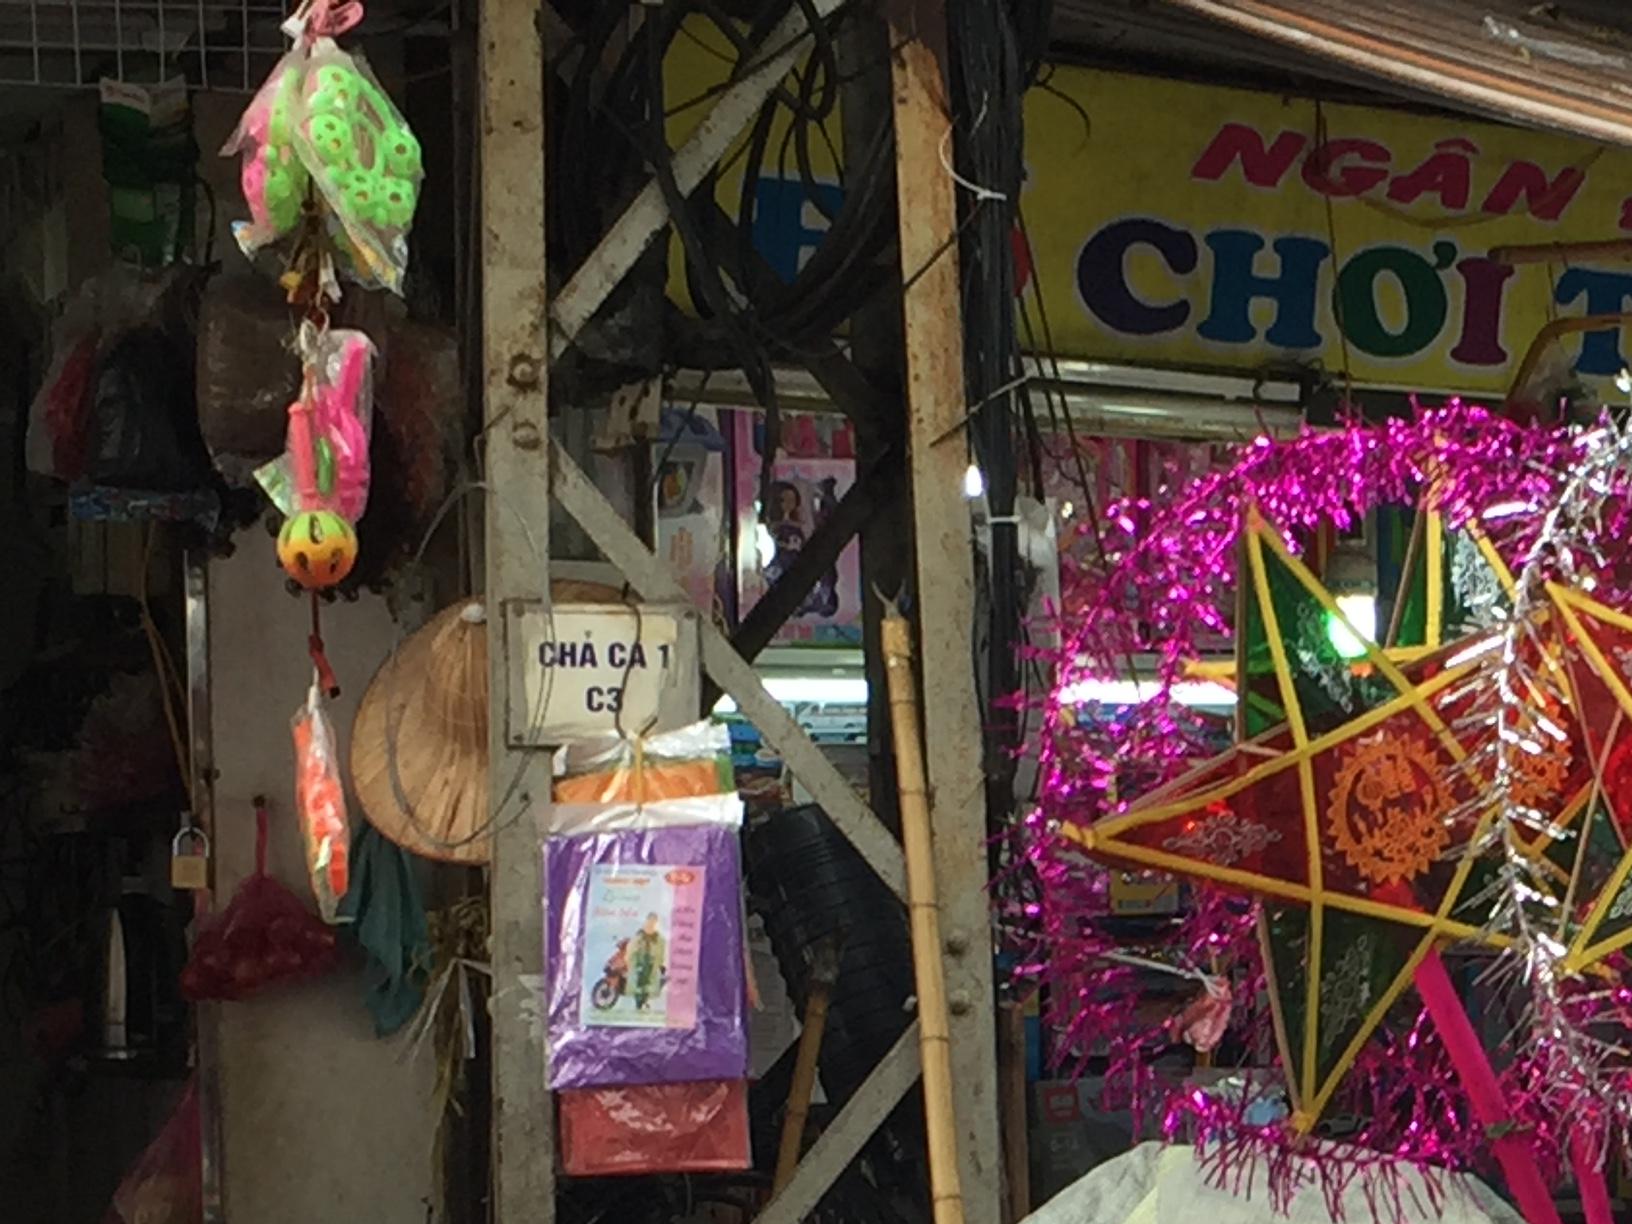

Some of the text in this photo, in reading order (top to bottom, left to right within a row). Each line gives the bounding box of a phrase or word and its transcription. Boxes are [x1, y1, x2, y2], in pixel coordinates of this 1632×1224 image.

[1190, 121, 1587, 221] NGÂN
[1076, 217, 1512, 367] CHƠI
[538, 630, 599, 668] CHẢ
[656, 644, 670, 669] 1
[586, 686, 623, 713] C3
